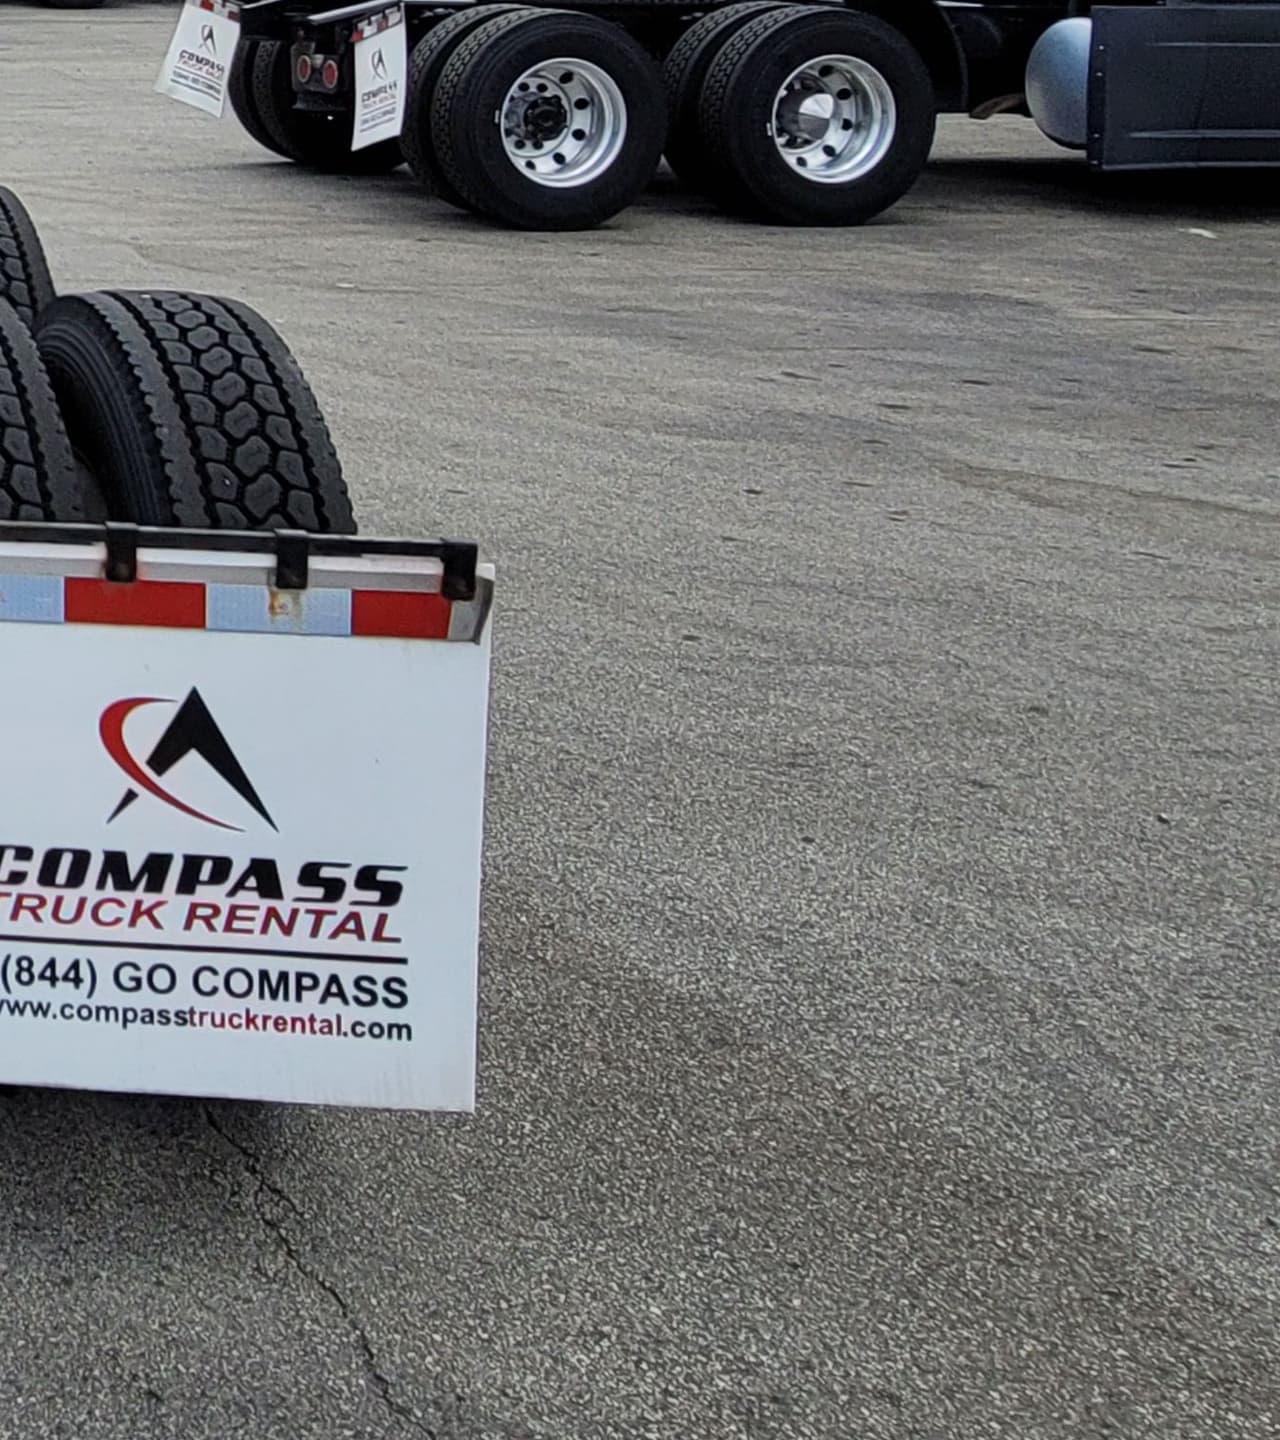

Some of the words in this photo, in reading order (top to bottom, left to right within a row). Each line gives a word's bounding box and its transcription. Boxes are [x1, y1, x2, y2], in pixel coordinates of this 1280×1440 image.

[183, 900, 403, 944] RENTAL
[113, 962, 177, 995] GO
[192, 965, 409, 1010] COMPASS
